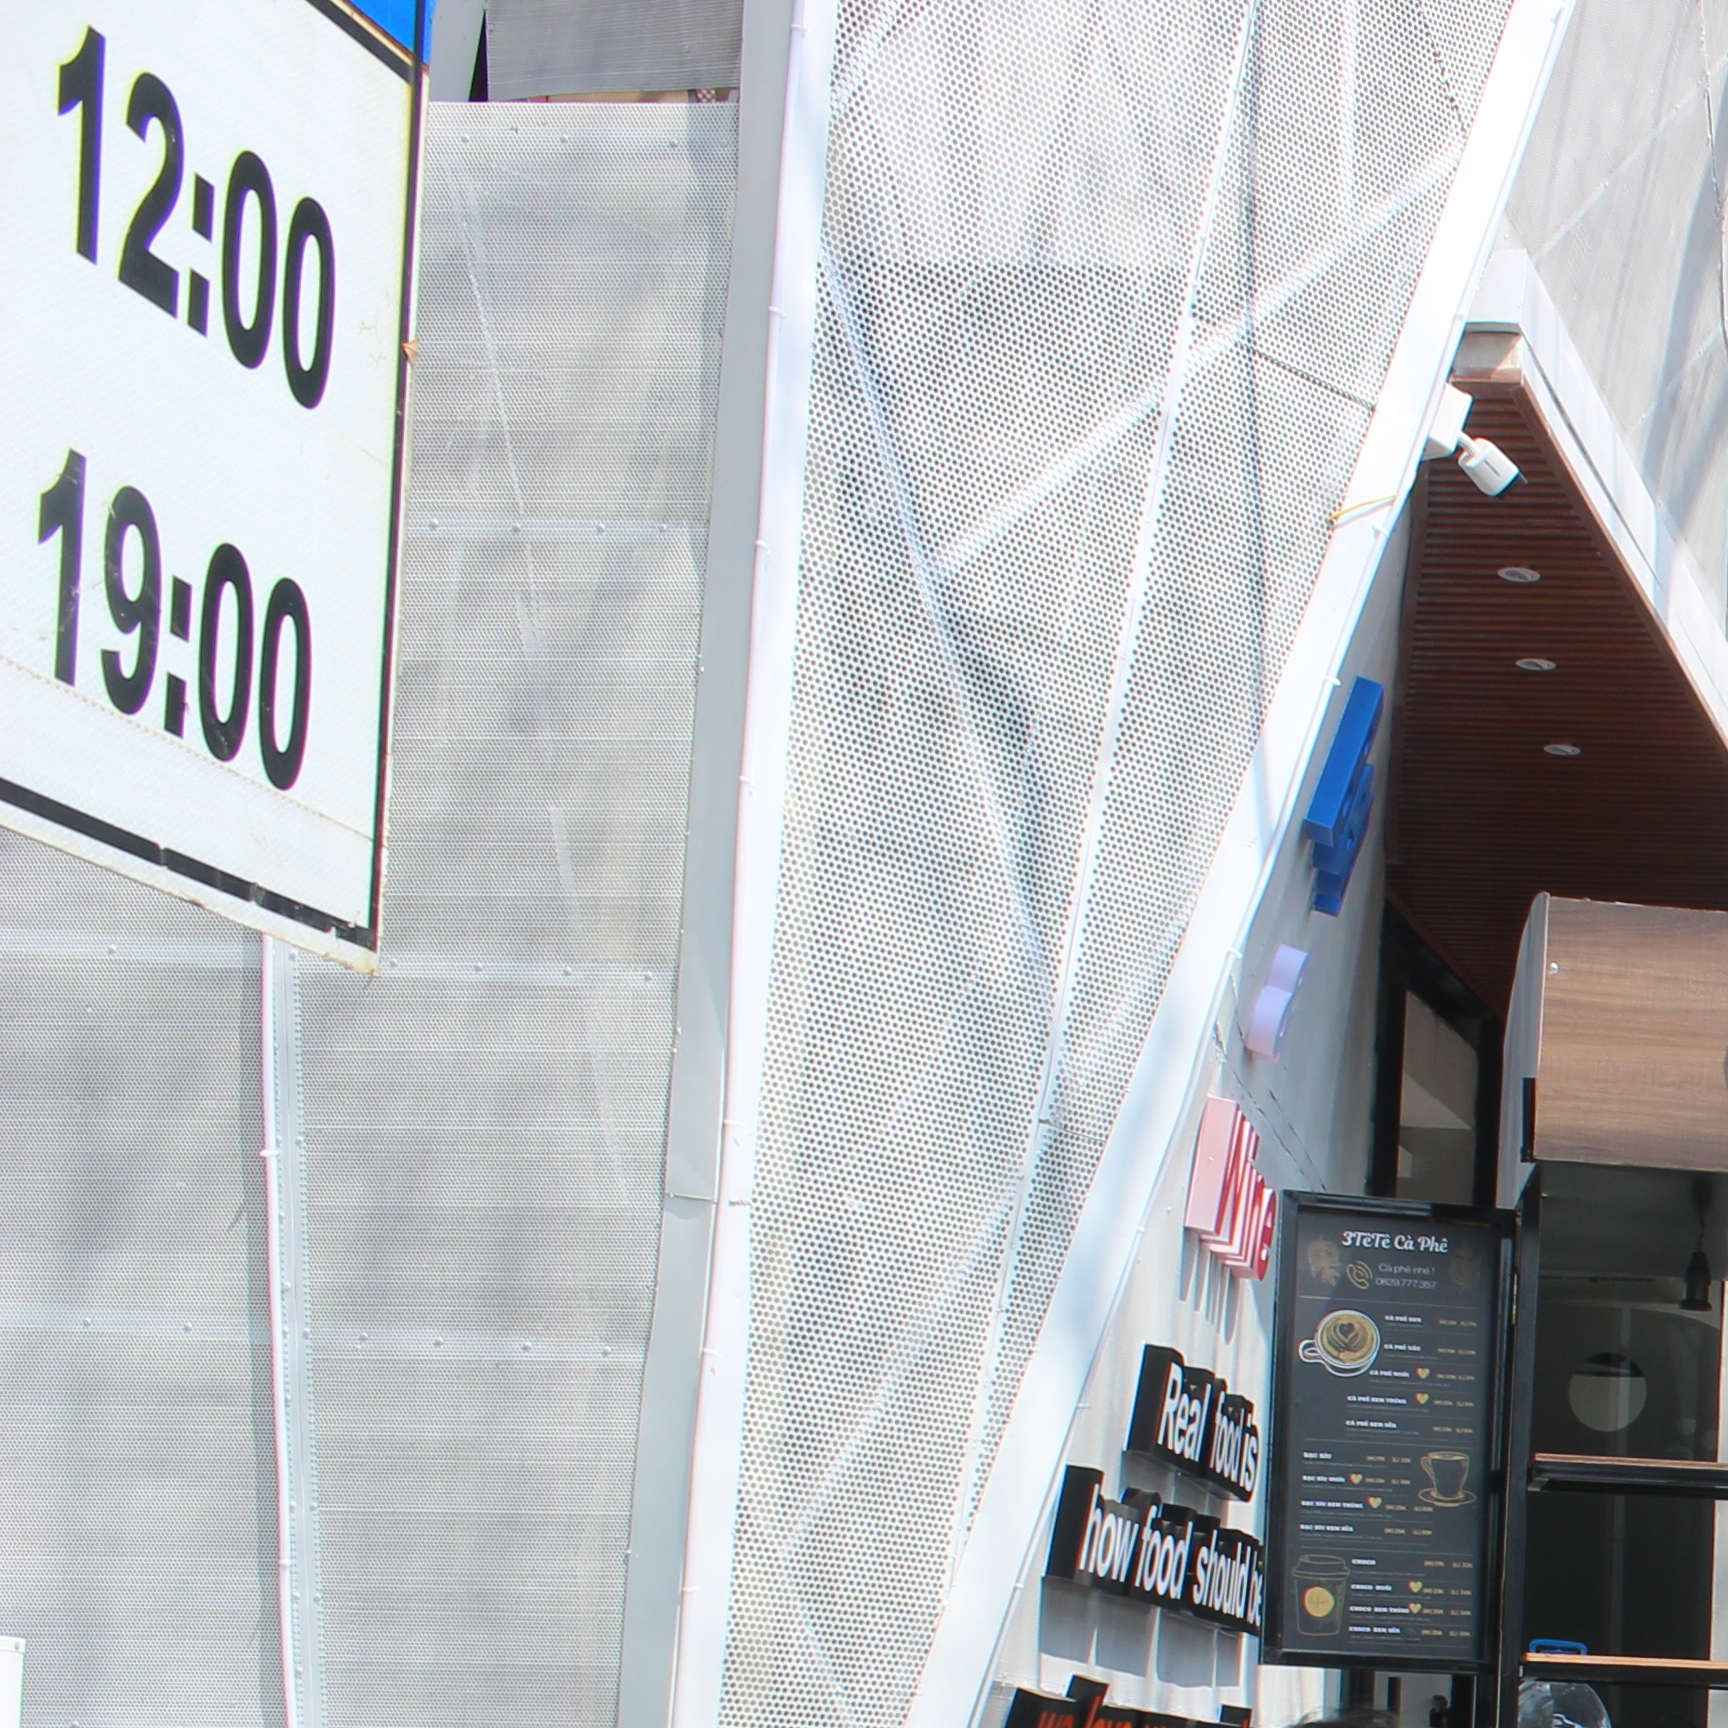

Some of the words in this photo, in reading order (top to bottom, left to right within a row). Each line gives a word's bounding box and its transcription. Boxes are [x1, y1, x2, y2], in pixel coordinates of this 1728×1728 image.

[57, 25, 336, 409] 12:00
[37, 447, 313, 791] 19:00
[1393, 1234, 1415, 1251] Cà
[1417, 1236, 1449, 1253] Phê
[1157, 1361, 1212, 1464] Real
[1209, 1389, 1244, 1483] food
[1240, 1412, 1260, 1493] is
[1078, 1483, 1141, 1584] how
[1134, 1502, 1193, 1602] food
[1192, 1529, 1251, 1619] should
